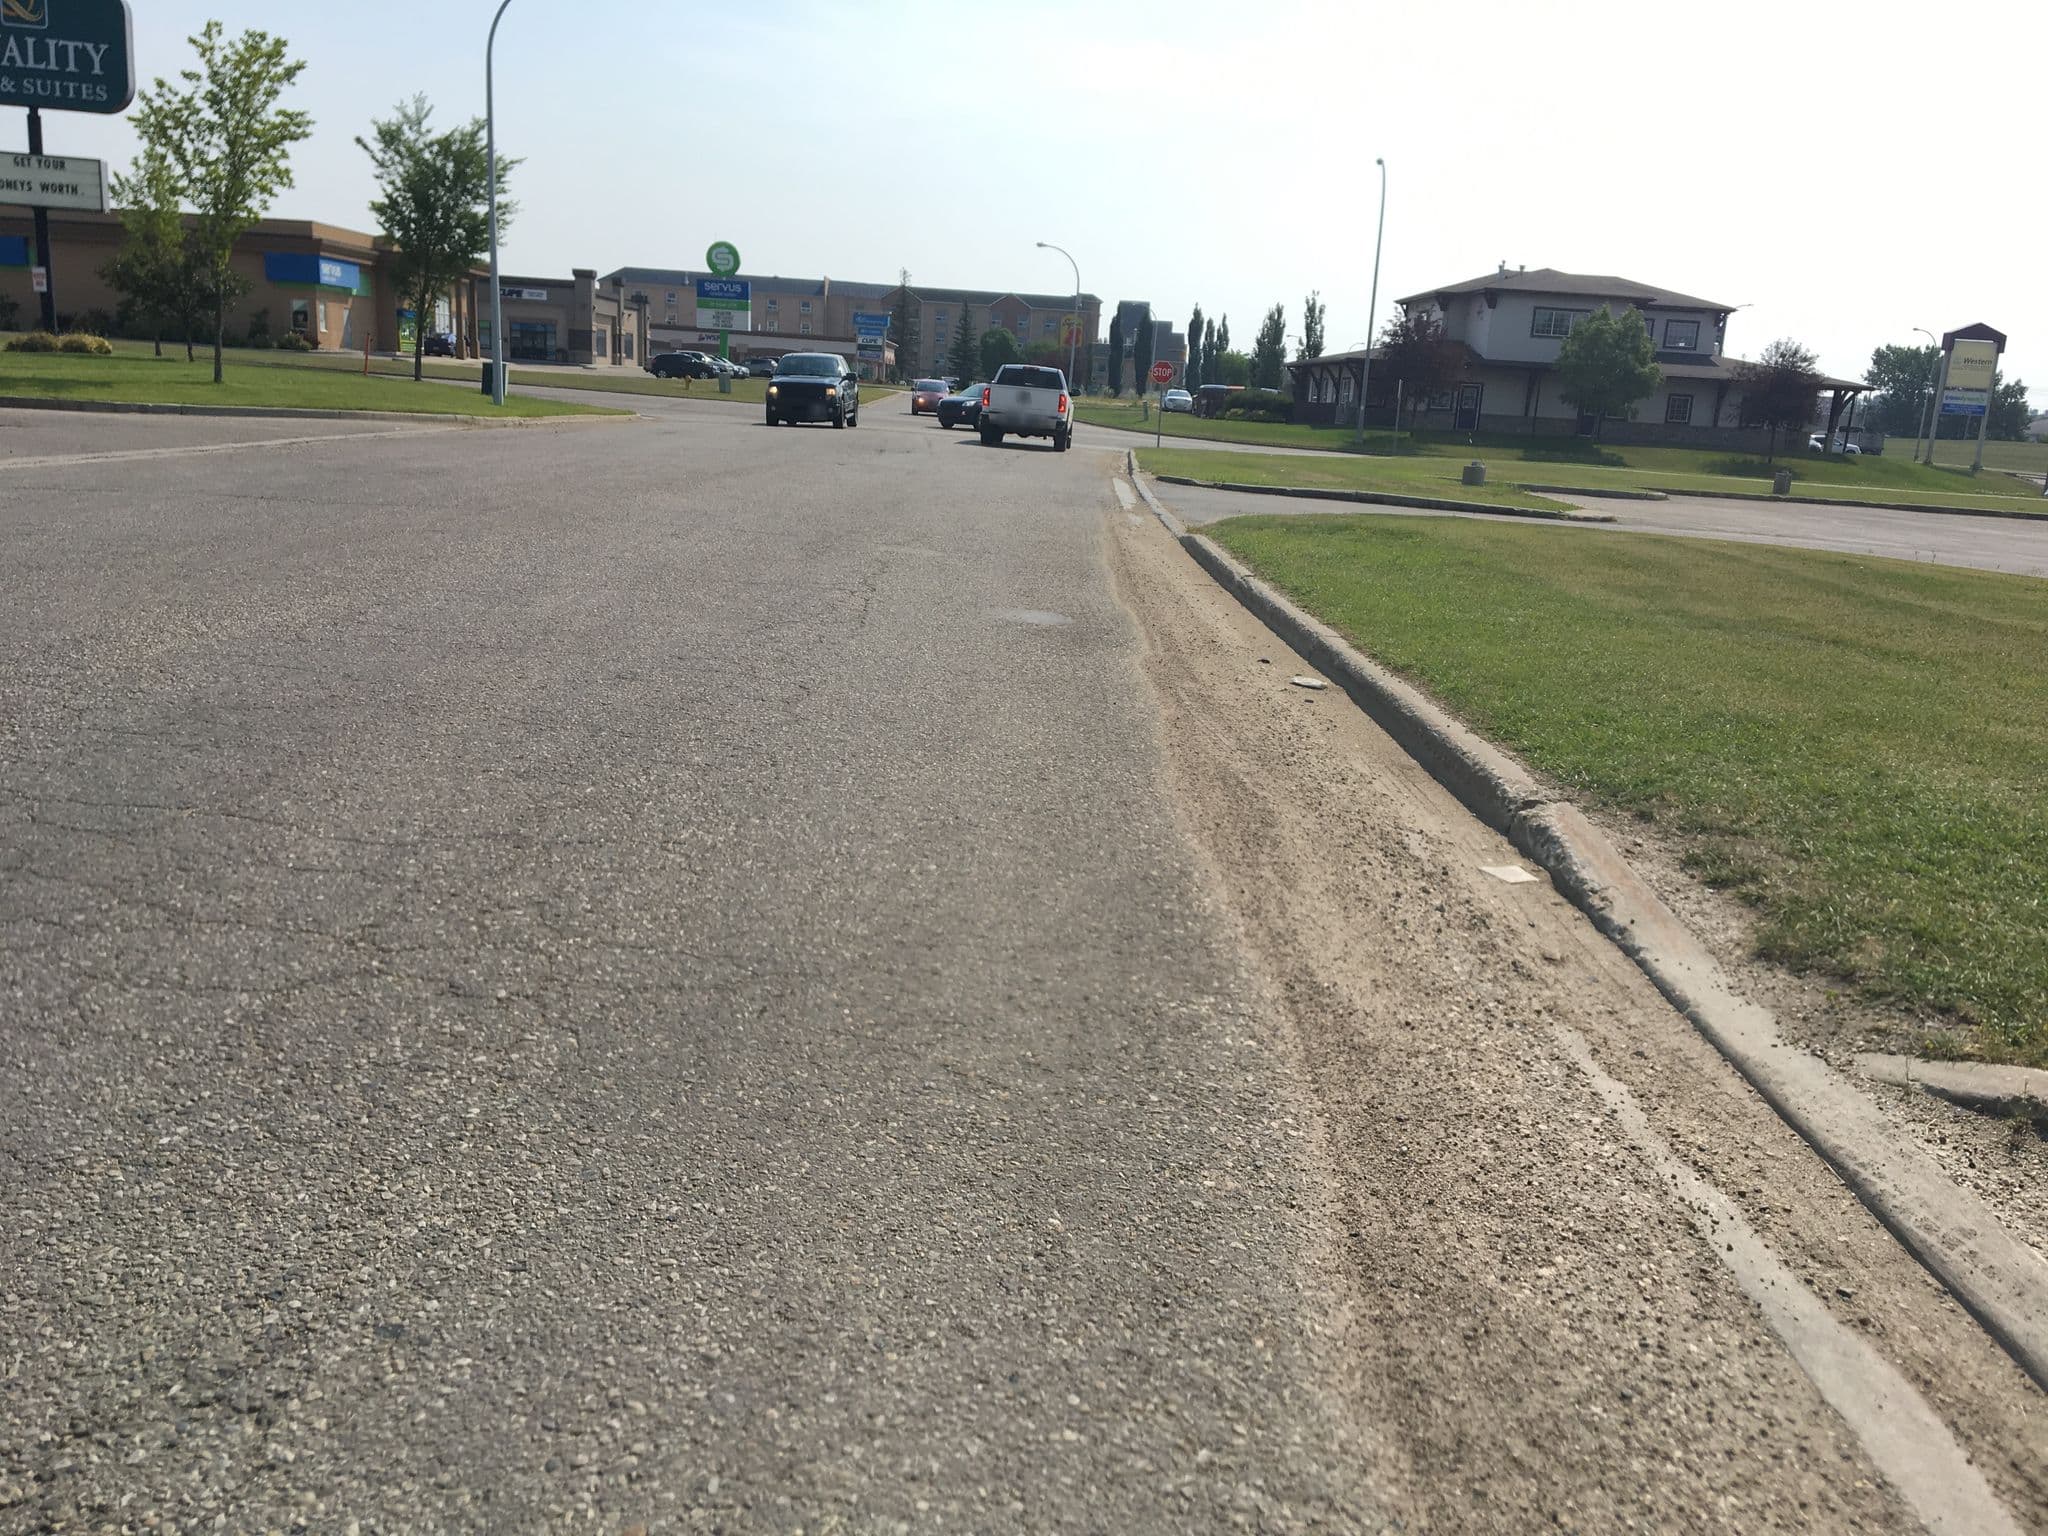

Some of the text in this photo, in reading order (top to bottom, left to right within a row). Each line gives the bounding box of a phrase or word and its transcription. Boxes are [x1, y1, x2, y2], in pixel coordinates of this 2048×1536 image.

[0, 34, 109, 75] ALITY
[0, 75, 109, 102] & SUITES
[13, 156, 67, 170] GET YOUR
[704, 282, 742, 292] servus
[1964, 357, 1993, 366] Western
[1154, 367, 1172, 377] STOP
